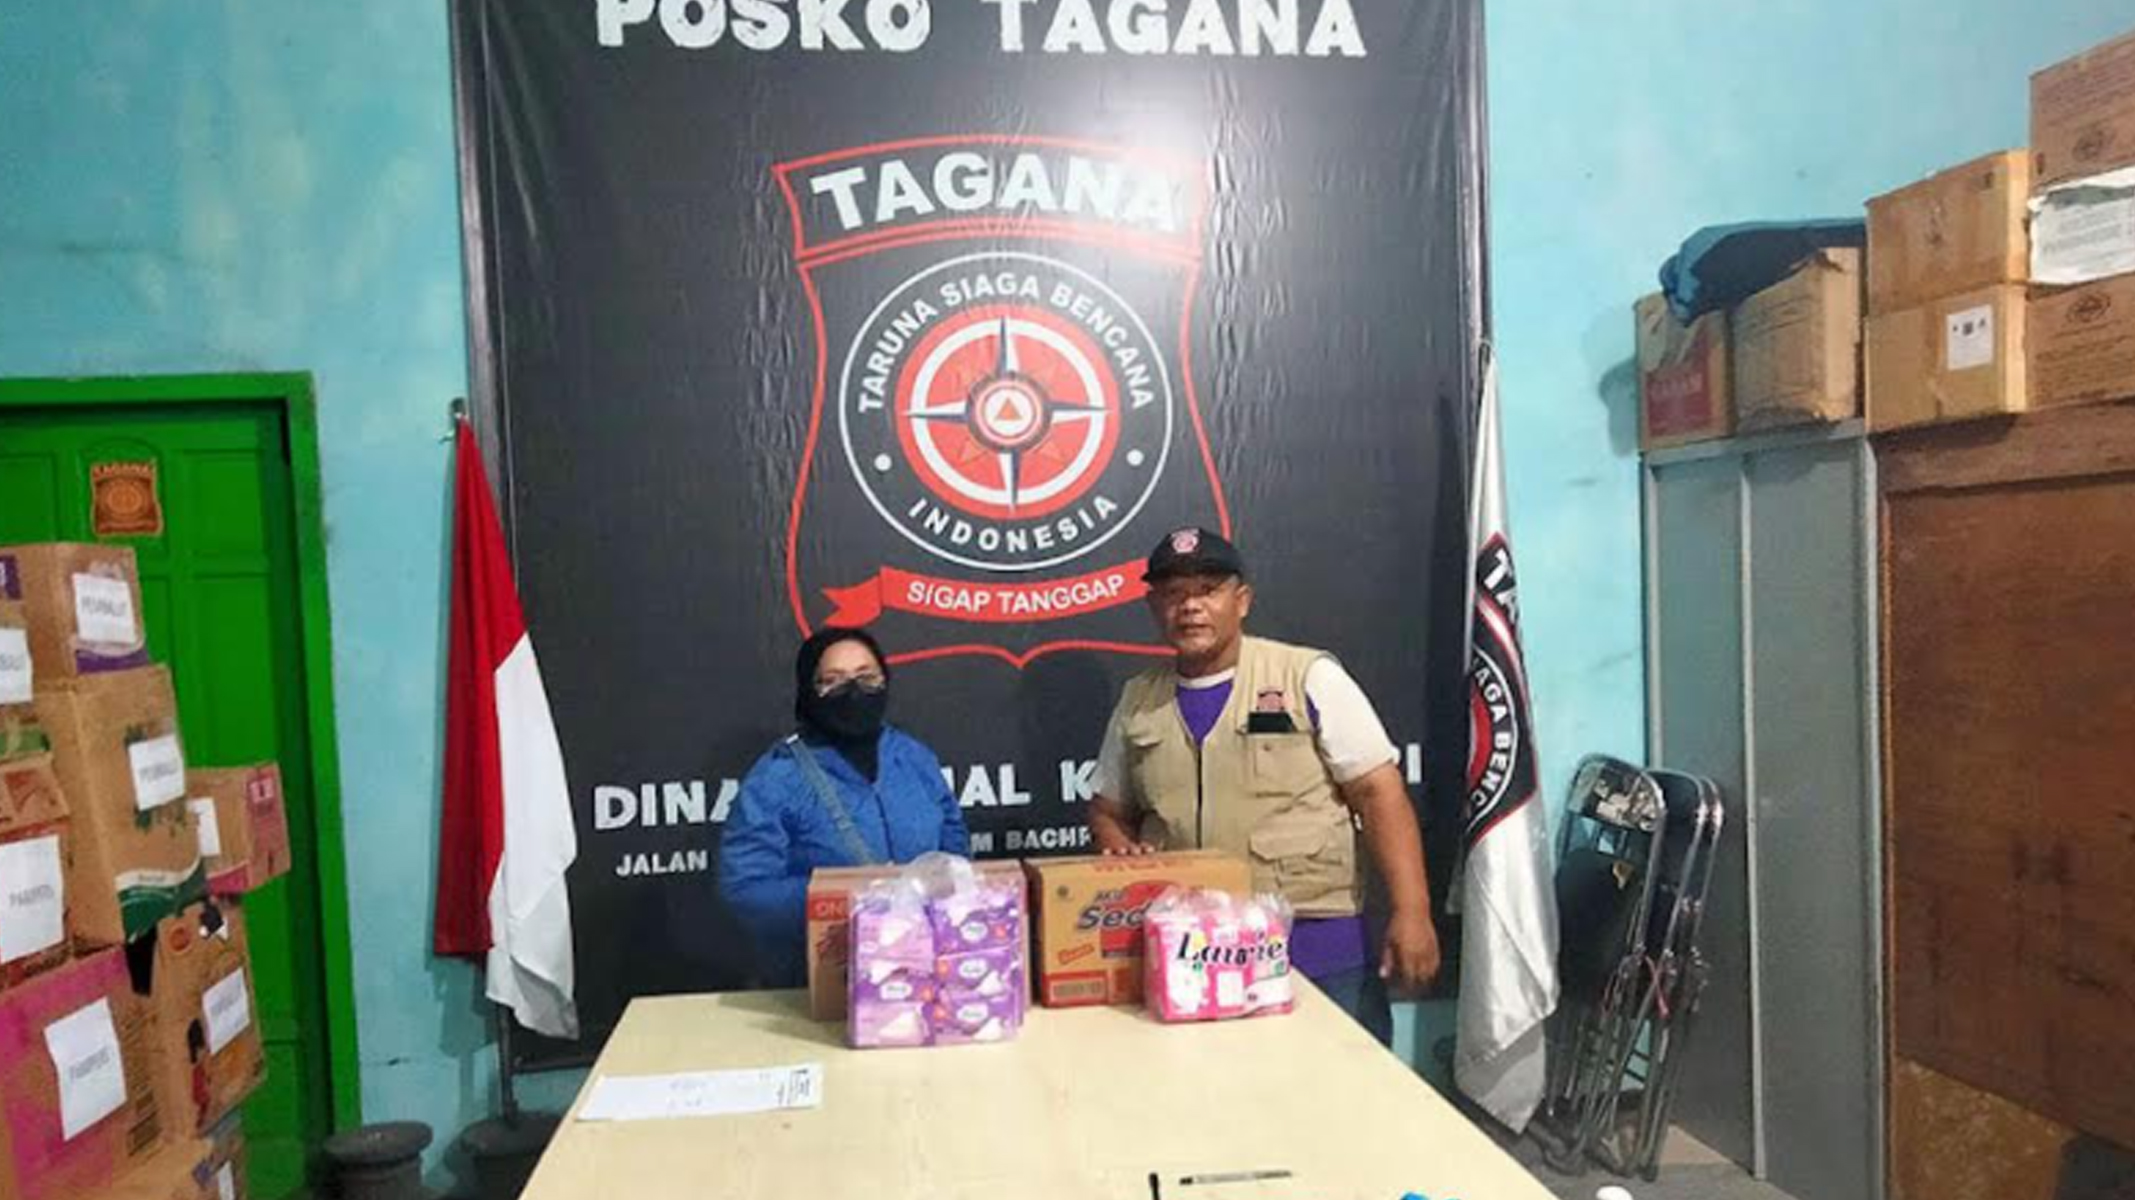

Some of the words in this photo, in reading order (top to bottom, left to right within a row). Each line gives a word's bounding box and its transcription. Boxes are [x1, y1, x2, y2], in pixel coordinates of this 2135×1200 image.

[597, 0, 931, 52] POSKO
[982, 0, 1366, 57] TAGANA
[810, 151, 1180, 232] TAGANA
[858, 298, 938, 414] TARUNA
[940, 271, 1041, 307] SIAGA
[1050, 281, 1155, 410] BENCANA
[908, 494, 1119, 553] INDONESIA
[906, 580, 992, 611] SIGAP
[996, 574, 1126, 614] TANGGAP
[616, 850, 708, 877] JALAN
